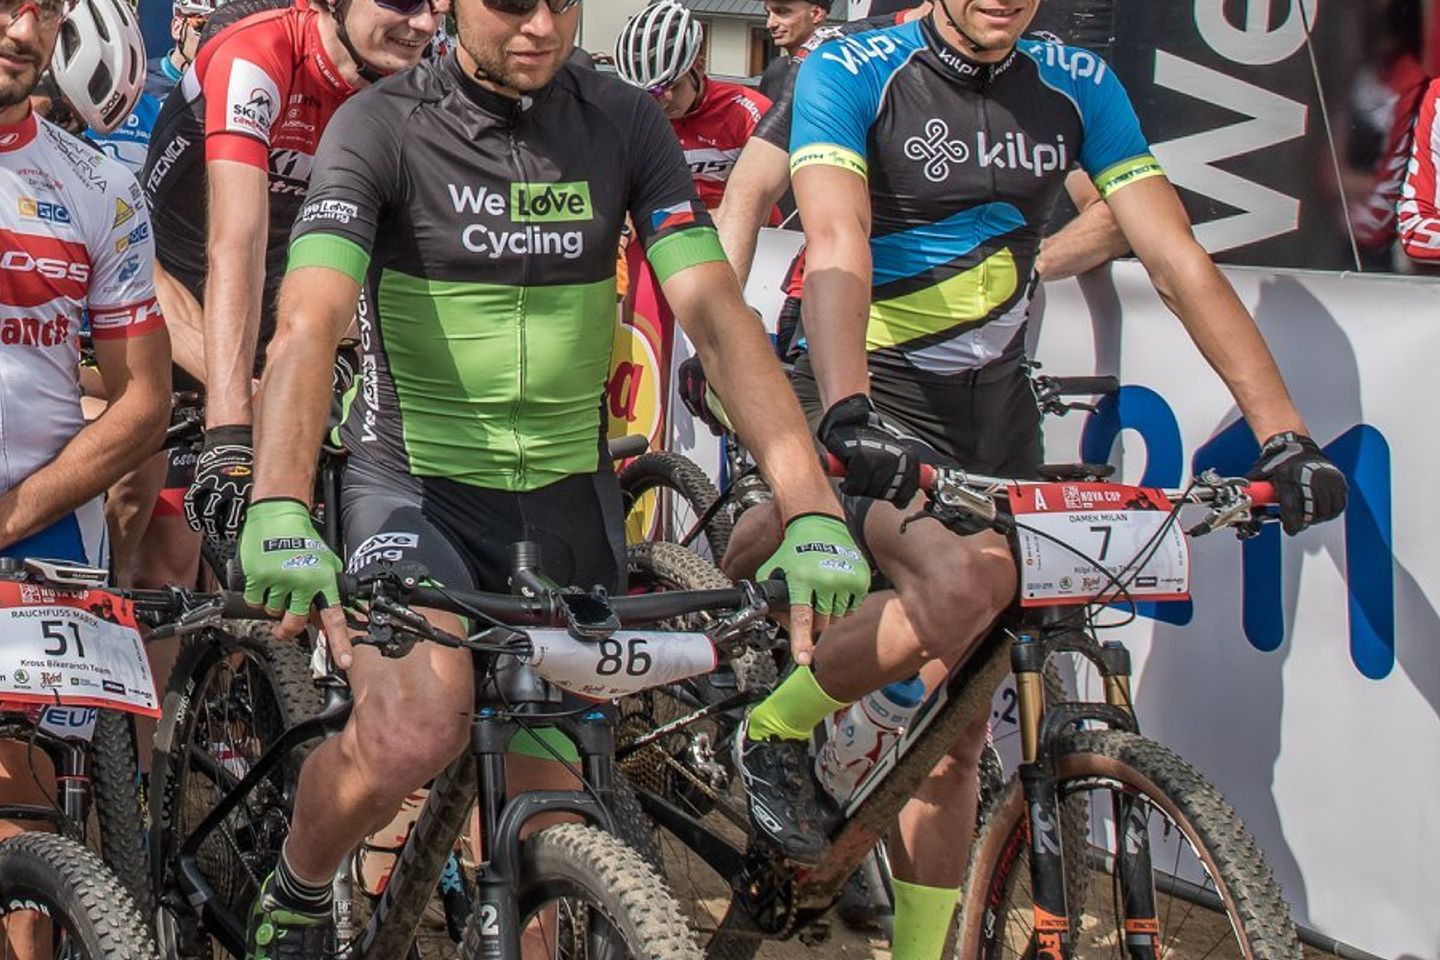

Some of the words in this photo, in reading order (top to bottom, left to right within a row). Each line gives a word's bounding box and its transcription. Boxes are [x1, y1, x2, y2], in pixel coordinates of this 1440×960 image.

[977, 130, 1066, 178] kilpi
[448, 183, 505, 216] We
[519, 181, 585, 217] Love
[462, 223, 584, 259] Cycling
[1034, 488, 1048, 510] A
[1089, 526, 1112, 561] 7
[11, 608, 72, 619] RAUCHFUSS
[41, 620, 86, 659] 51
[596, 638, 652, 676] 86
[20, 659, 46, 668] Kross
